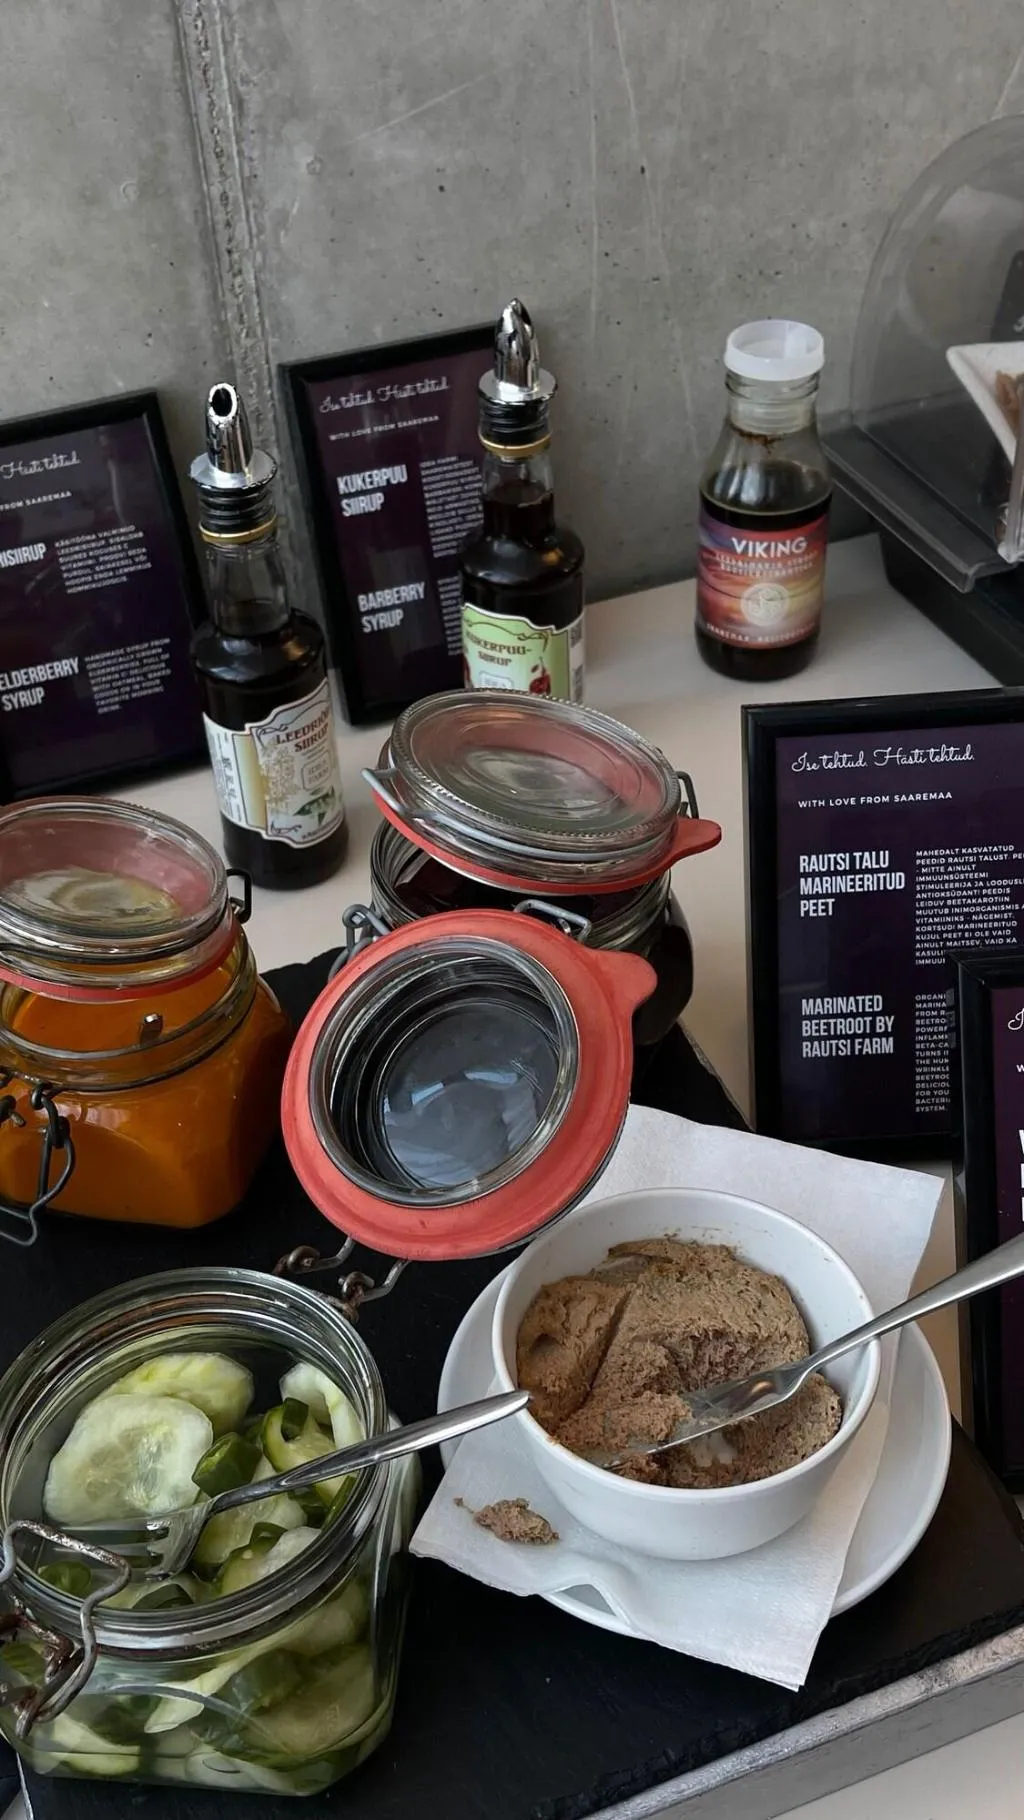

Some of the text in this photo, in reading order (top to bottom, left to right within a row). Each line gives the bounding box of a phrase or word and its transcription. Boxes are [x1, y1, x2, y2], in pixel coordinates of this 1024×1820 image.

[329, 415, 439, 441] WITH LOVE FROM SAAREMAA
[336, 464, 408, 494] KUKERPUU
[25, 490, 72, 506] SAAREMAA
[341, 492, 385, 516] SIIRUP
[0, 542, 46, 568] ISIIRUP
[732, 536, 808, 558] VIKING
[358, 581, 425, 612] BARBERRY
[362, 608, 404, 633] SYRUP
[0, 656, 79, 690] ELDERBERRY
[2, 686, 45, 712] SYRUP
[792, 752, 820, 772] Ise
[798, 792, 952, 808] WITH LOVE FROM SAAREMAA
[916, 844, 1014, 857] MAHEDALT KASVATATUD
[800, 850, 890, 873] RAUTSI TALU
[916, 858, 946, 866] PEEDID
[948, 864, 976, 872] AINULT
[800, 872, 906, 896] MARINEERITUD
[916, 872, 988, 882] IMMUUNSÜSTEEMI
[916, 881, 972, 891] STIMULEERIJA
[800, 898, 836, 918] PEET
[916, 896, 1010, 908] LEIDUV BEETAKAROTIIN
[952, 904, 1020, 914] INIMORGANISMIS
[916, 916, 964, 924] VITAMIINIKS
[958, 920, 1018, 930] MARINEERITUD
[916, 941, 944, 949] AINULT
[802, 994, 883, 1016] MARINATED
[802, 1016, 894, 1036] BEETROOT BY
[802, 1036, 894, 1058] RAUTSI FARM
